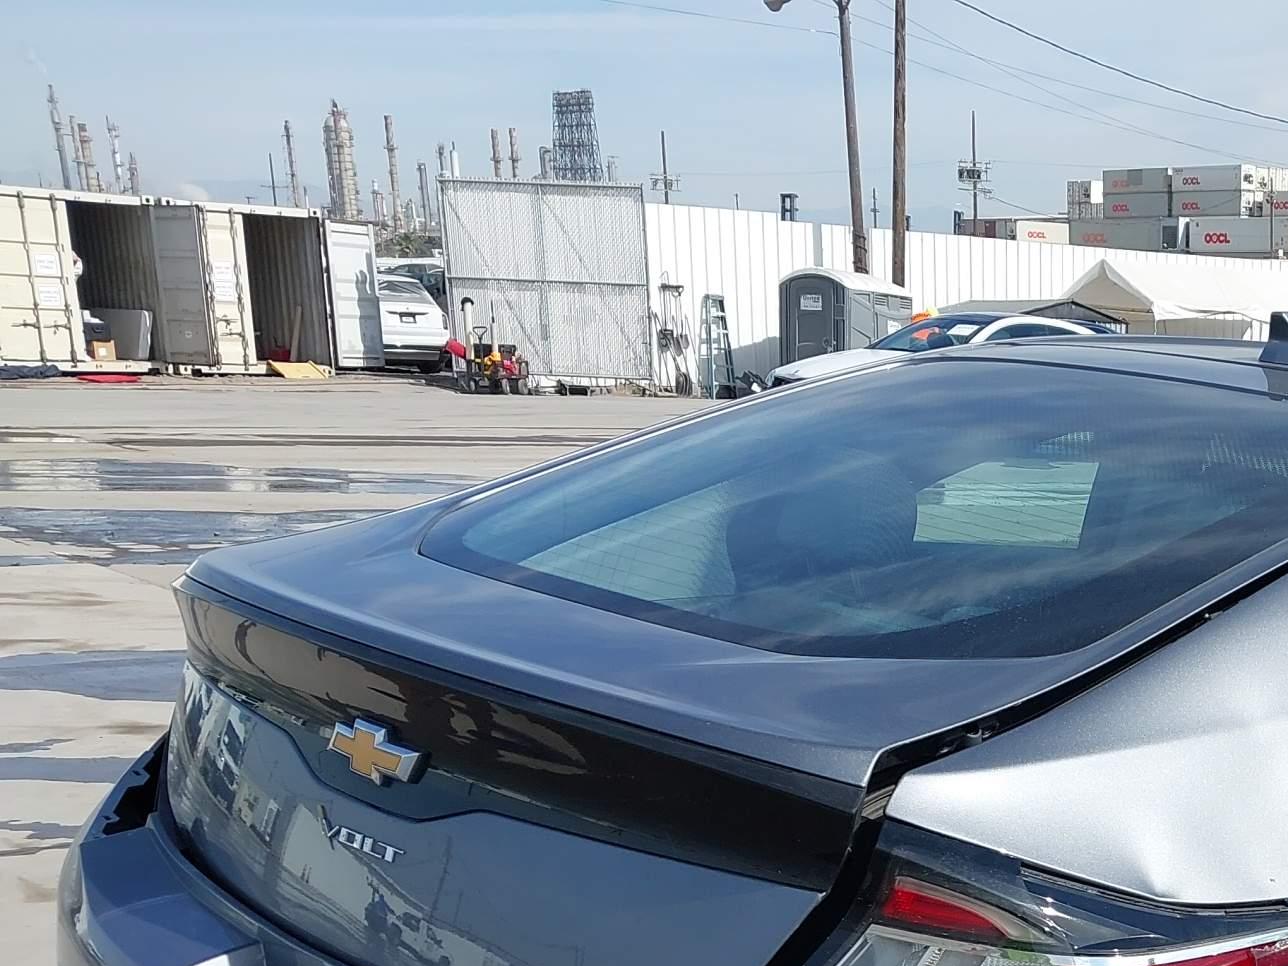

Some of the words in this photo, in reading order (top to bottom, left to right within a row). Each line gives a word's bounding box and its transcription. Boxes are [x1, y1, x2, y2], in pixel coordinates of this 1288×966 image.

[1182, 176, 1200, 186] OOCL
[1111, 203, 1130, 212] OOCL
[1181, 202, 1200, 210] OOCL
[1027, 231, 1046, 239] OOCL
[1204, 232, 1230, 244] OOCL
[321, 804, 405, 863] VOLT
